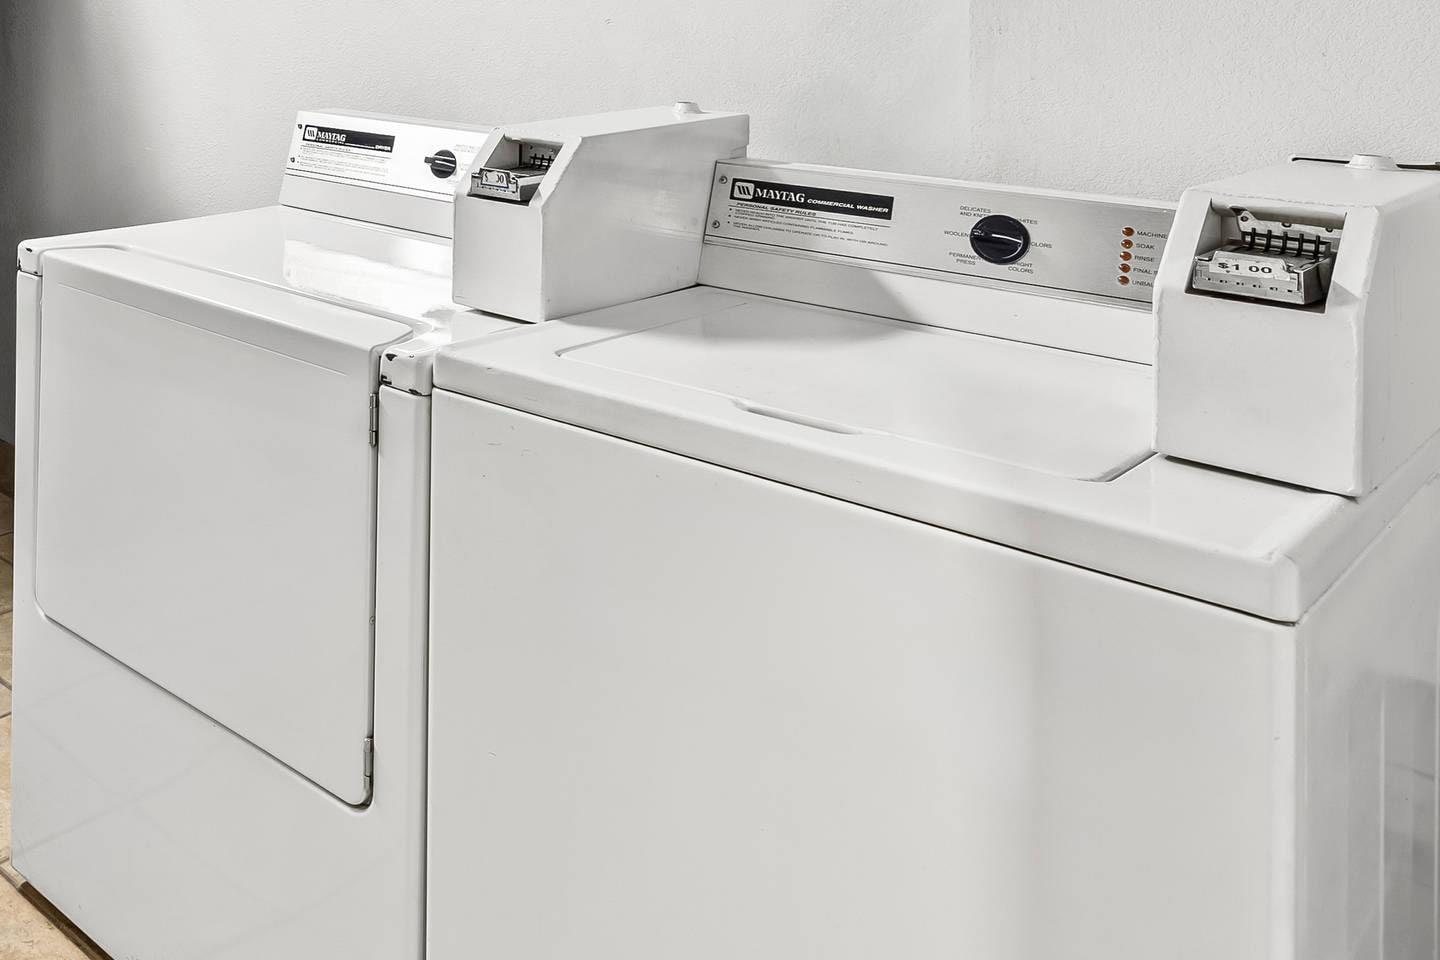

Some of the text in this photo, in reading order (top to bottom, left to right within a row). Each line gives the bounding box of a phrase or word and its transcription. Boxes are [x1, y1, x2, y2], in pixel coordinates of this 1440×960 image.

[316, 131, 347, 143] MAYTAG
[755, 187, 889, 213] MAYTAG COMMERCIAL WASHER
[736, 202, 768, 210] PERSONAL
[769, 206, 794, 214] SAFETY
[794, 209, 817, 217] RULES
[959, 205, 991, 214] DELICATES
[943, 230, 970, 238] WOOLEN
[1136, 231, 1168, 240] MACHINE
[1030, 241, 1053, 249] OLORS
[956, 258, 977, 266] PRESS
[1007, 265, 1034, 274] COLORS
[1133, 267, 1153, 275] FINAL
[1248, 265, 1273, 274] 00
